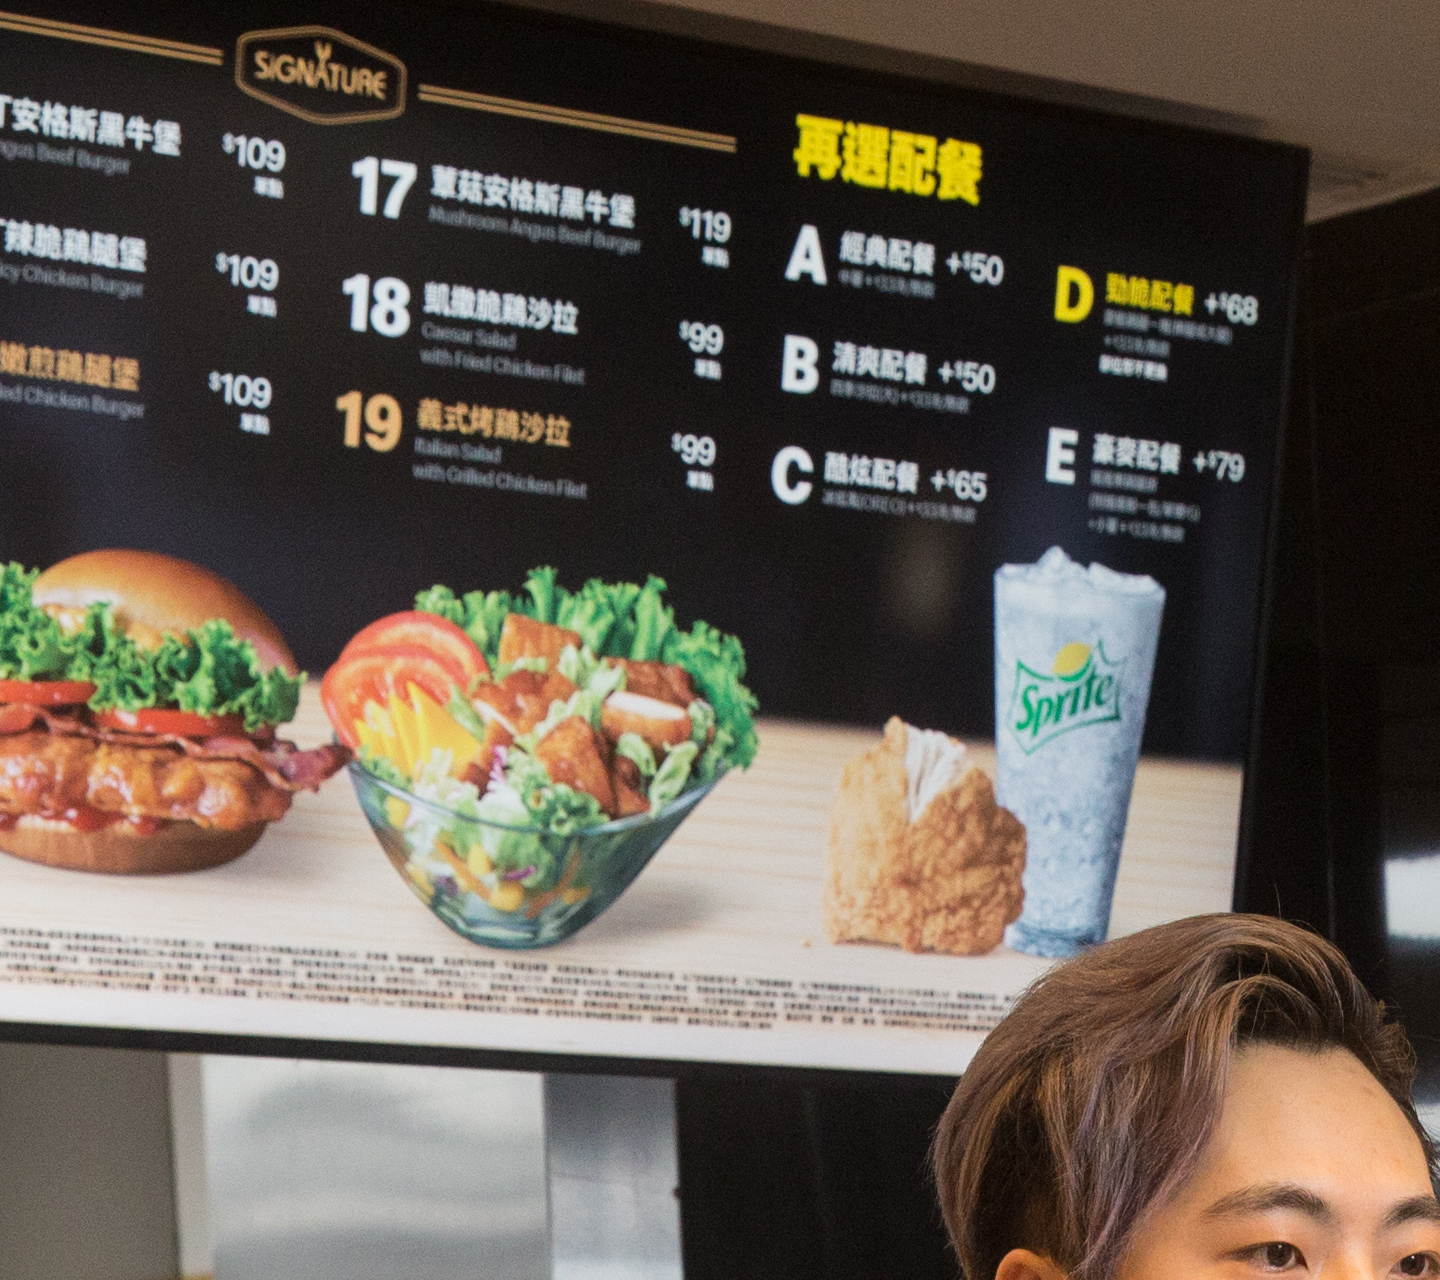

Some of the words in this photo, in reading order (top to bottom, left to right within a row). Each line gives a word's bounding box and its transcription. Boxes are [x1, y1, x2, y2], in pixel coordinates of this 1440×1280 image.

[222, 133, 286, 172] $109
[794, 113, 983, 206] 再選配餐
[351, 157, 417, 219] 17
[679, 207, 731, 243] $119
[215, 252, 279, 291] $109
[785, 224, 827, 286] A
[342, 273, 410, 337] 18
[1054, 265, 1094, 323] D
[679, 321, 724, 354] $99
[781, 334, 819, 394] B
[209, 371, 273, 409] $109
[336, 391, 402, 453] 19
[671, 433, 716, 467] $99
[770, 445, 814, 505] C
[1045, 427, 1079, 485] E
[1016, 671, 1114, 737] Sprite
